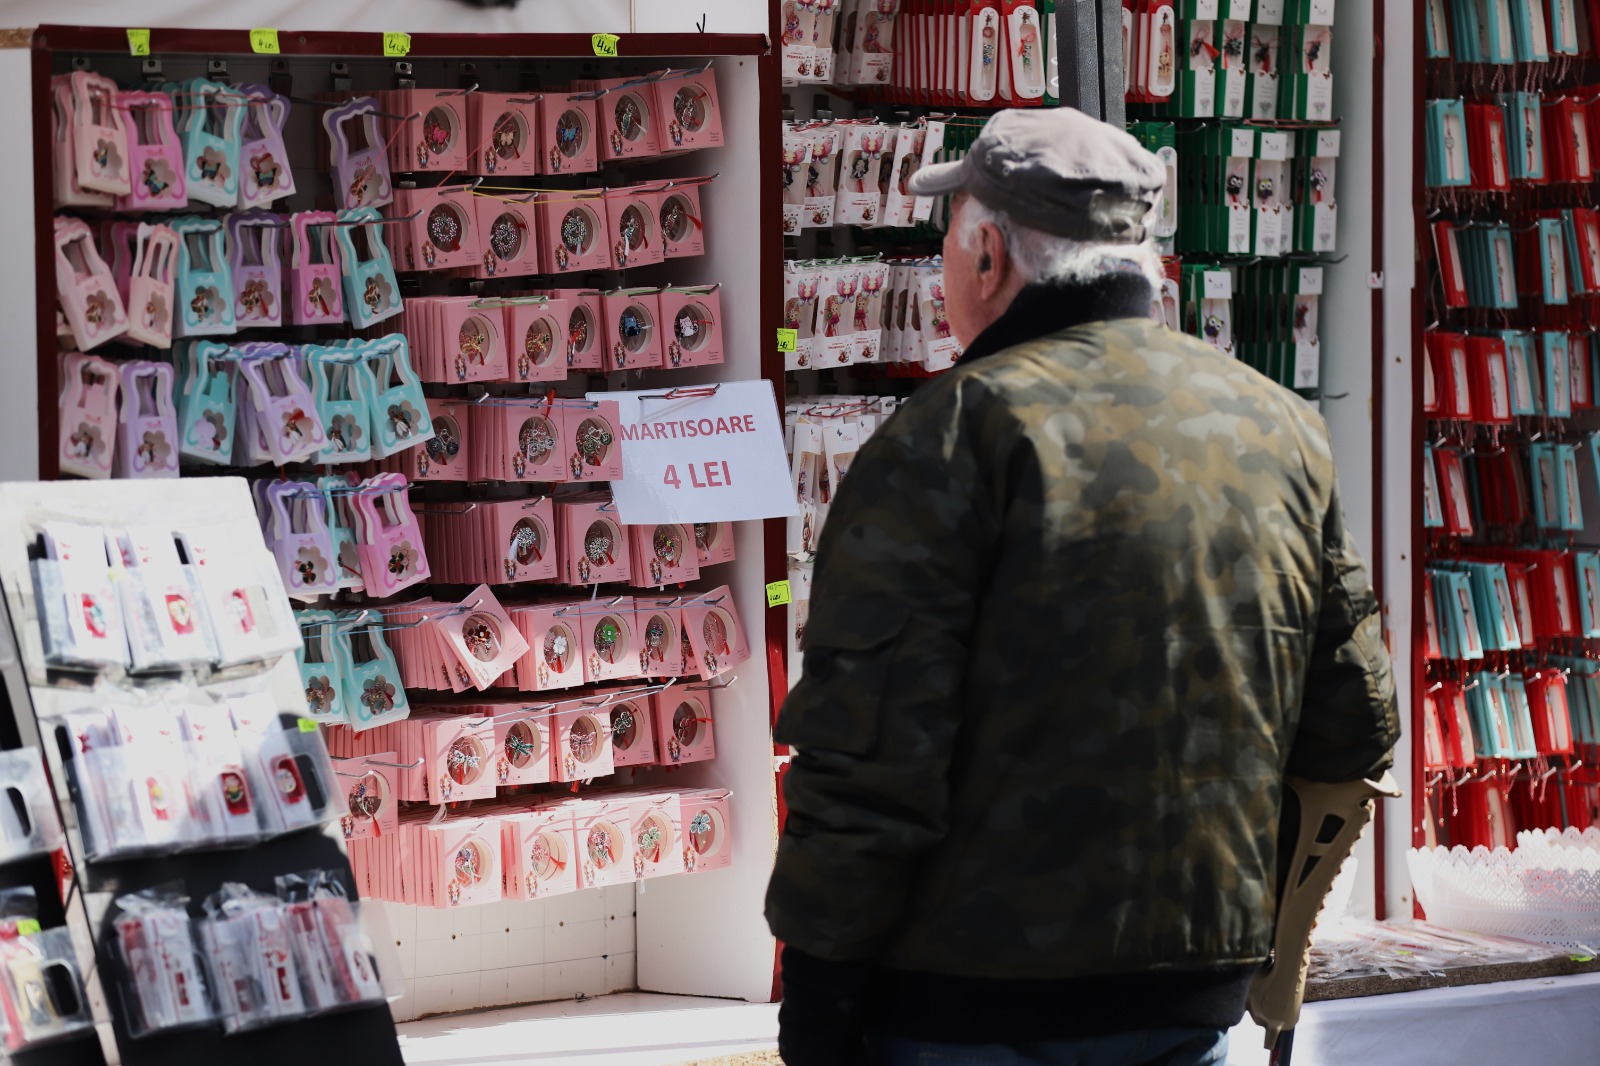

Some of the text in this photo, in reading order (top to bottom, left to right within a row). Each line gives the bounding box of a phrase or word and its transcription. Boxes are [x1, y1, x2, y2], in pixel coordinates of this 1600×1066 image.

[388, 38, 396, 52] 4
[596, 38, 605, 52] 4
[620, 414, 756, 441] MARTISOARE
[663, 460, 732, 489] 4 LEI
